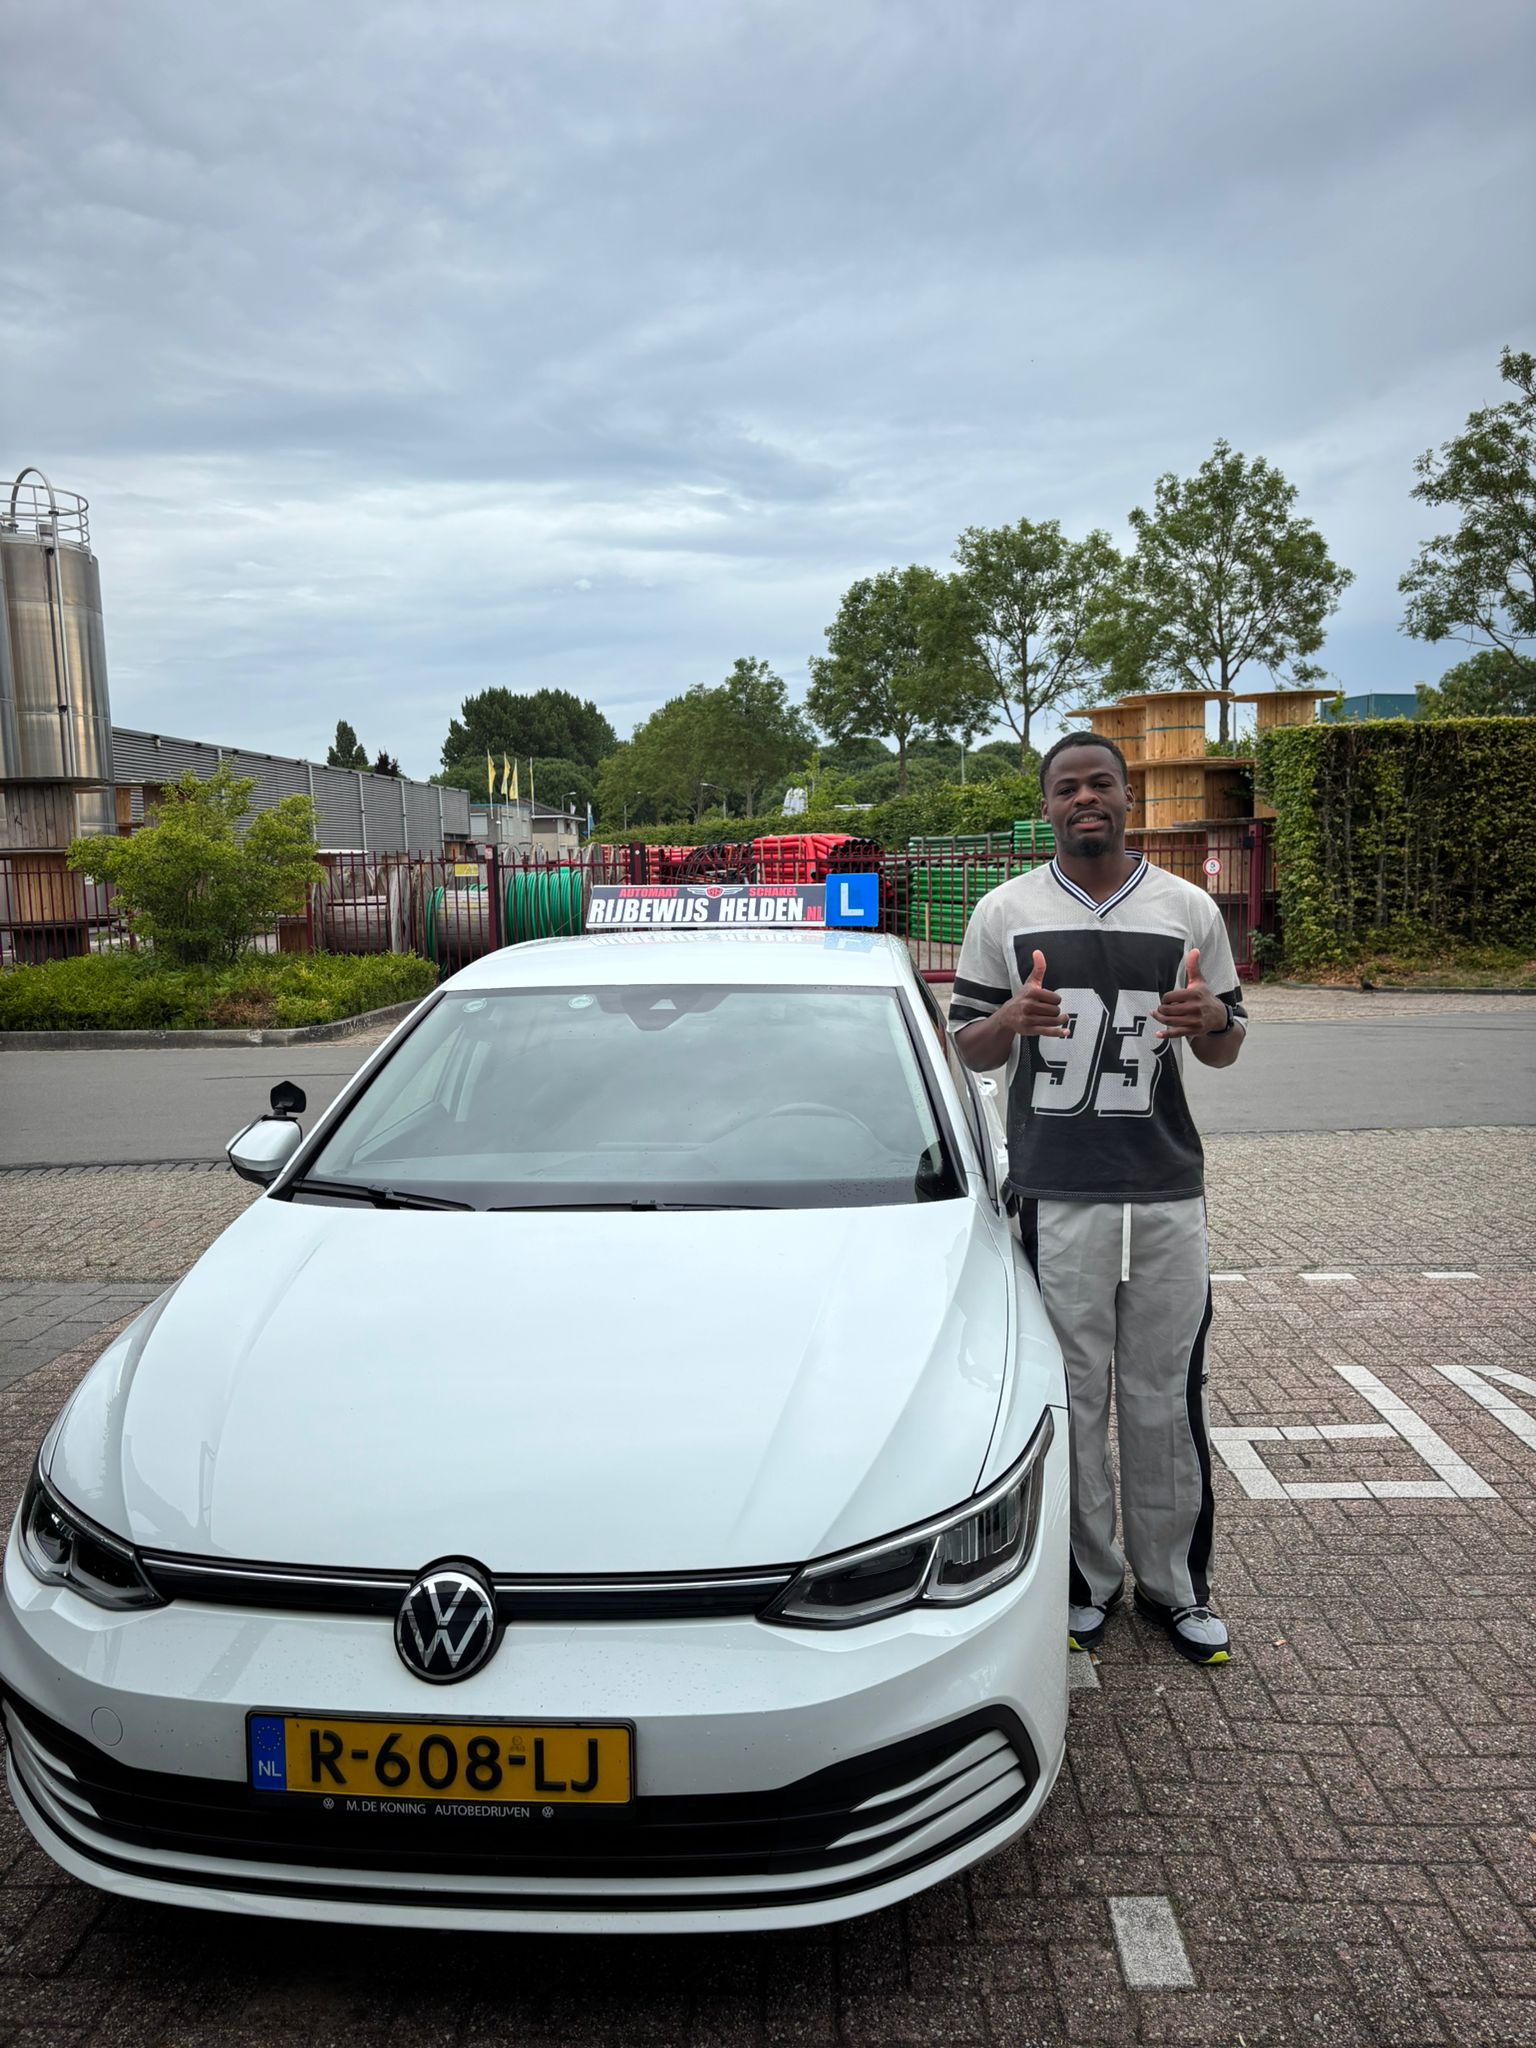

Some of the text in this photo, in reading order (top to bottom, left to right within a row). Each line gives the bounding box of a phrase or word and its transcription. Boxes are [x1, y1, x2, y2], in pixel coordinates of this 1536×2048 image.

[619, 887, 678, 898] AUTOMAAT
[748, 887, 797, 897] SCHAKEL
[840, 882, 864, 916] L
[588, 898, 709, 922] RIJBEWIJS
[1031, 987, 1172, 1117] 93
[258, 1760, 282, 1778] NL
[309, 1729, 599, 1793] R-608-LJ
[362, 1802, 378, 1813] DE
[379, 1802, 427, 1815] KONING
[434, 1805, 531, 1819] AUTOBEDRIJVEN
